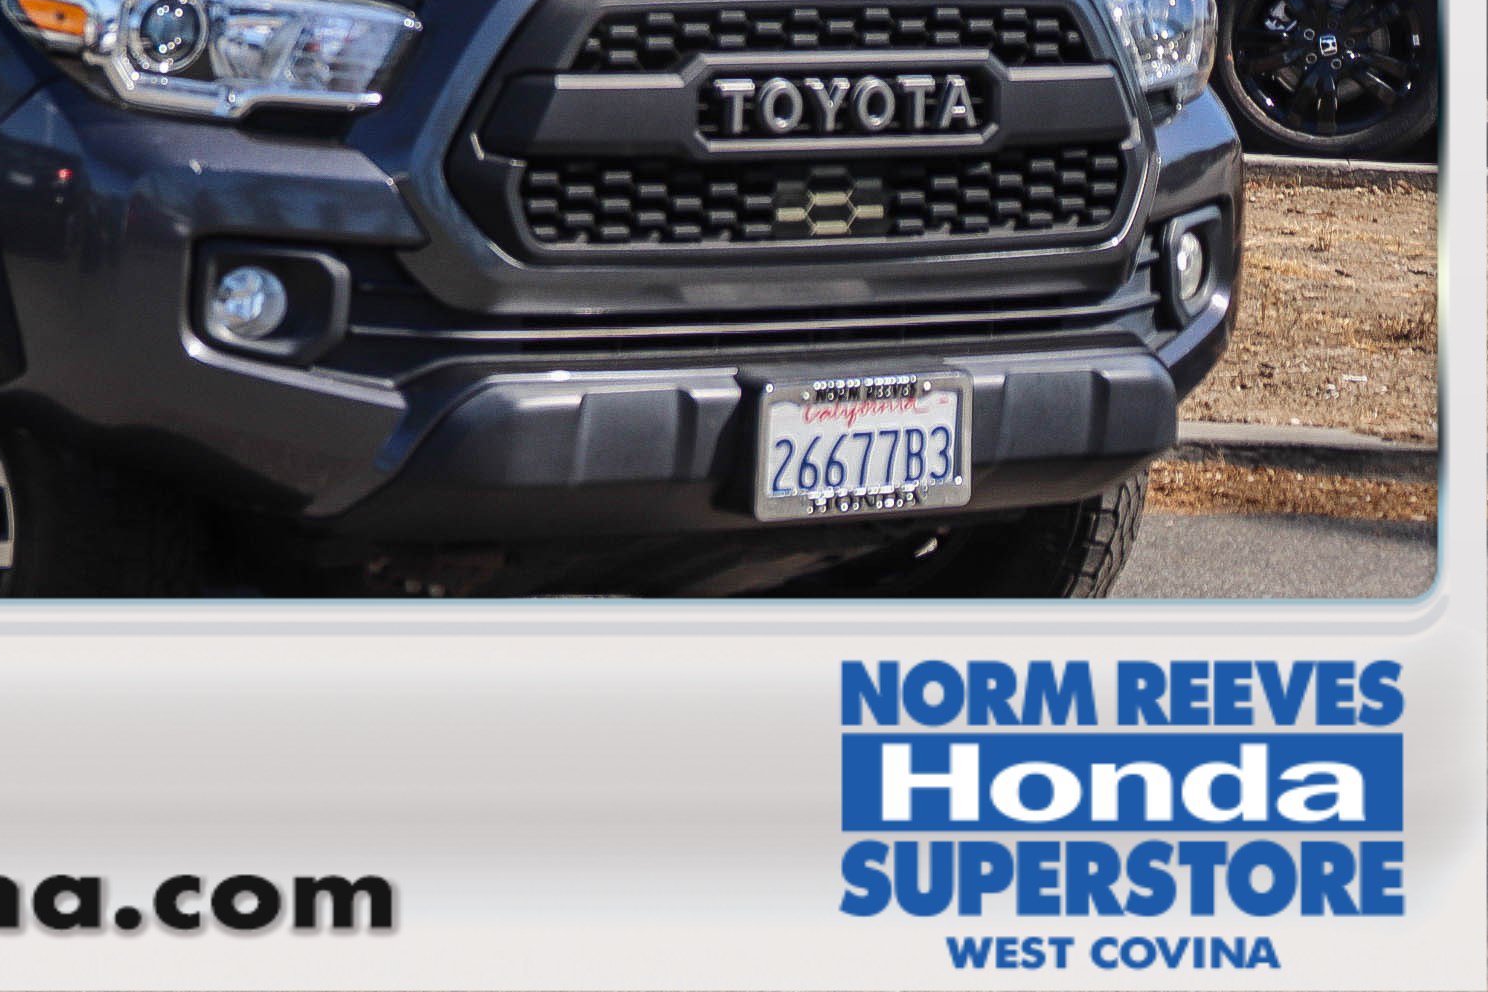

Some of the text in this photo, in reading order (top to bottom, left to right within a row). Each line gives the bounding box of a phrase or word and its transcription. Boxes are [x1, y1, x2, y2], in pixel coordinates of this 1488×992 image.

[714, 74, 978, 134] TOYOTA
[803, 397, 929, 429] California
[771, 425, 954, 493] 26677B3
